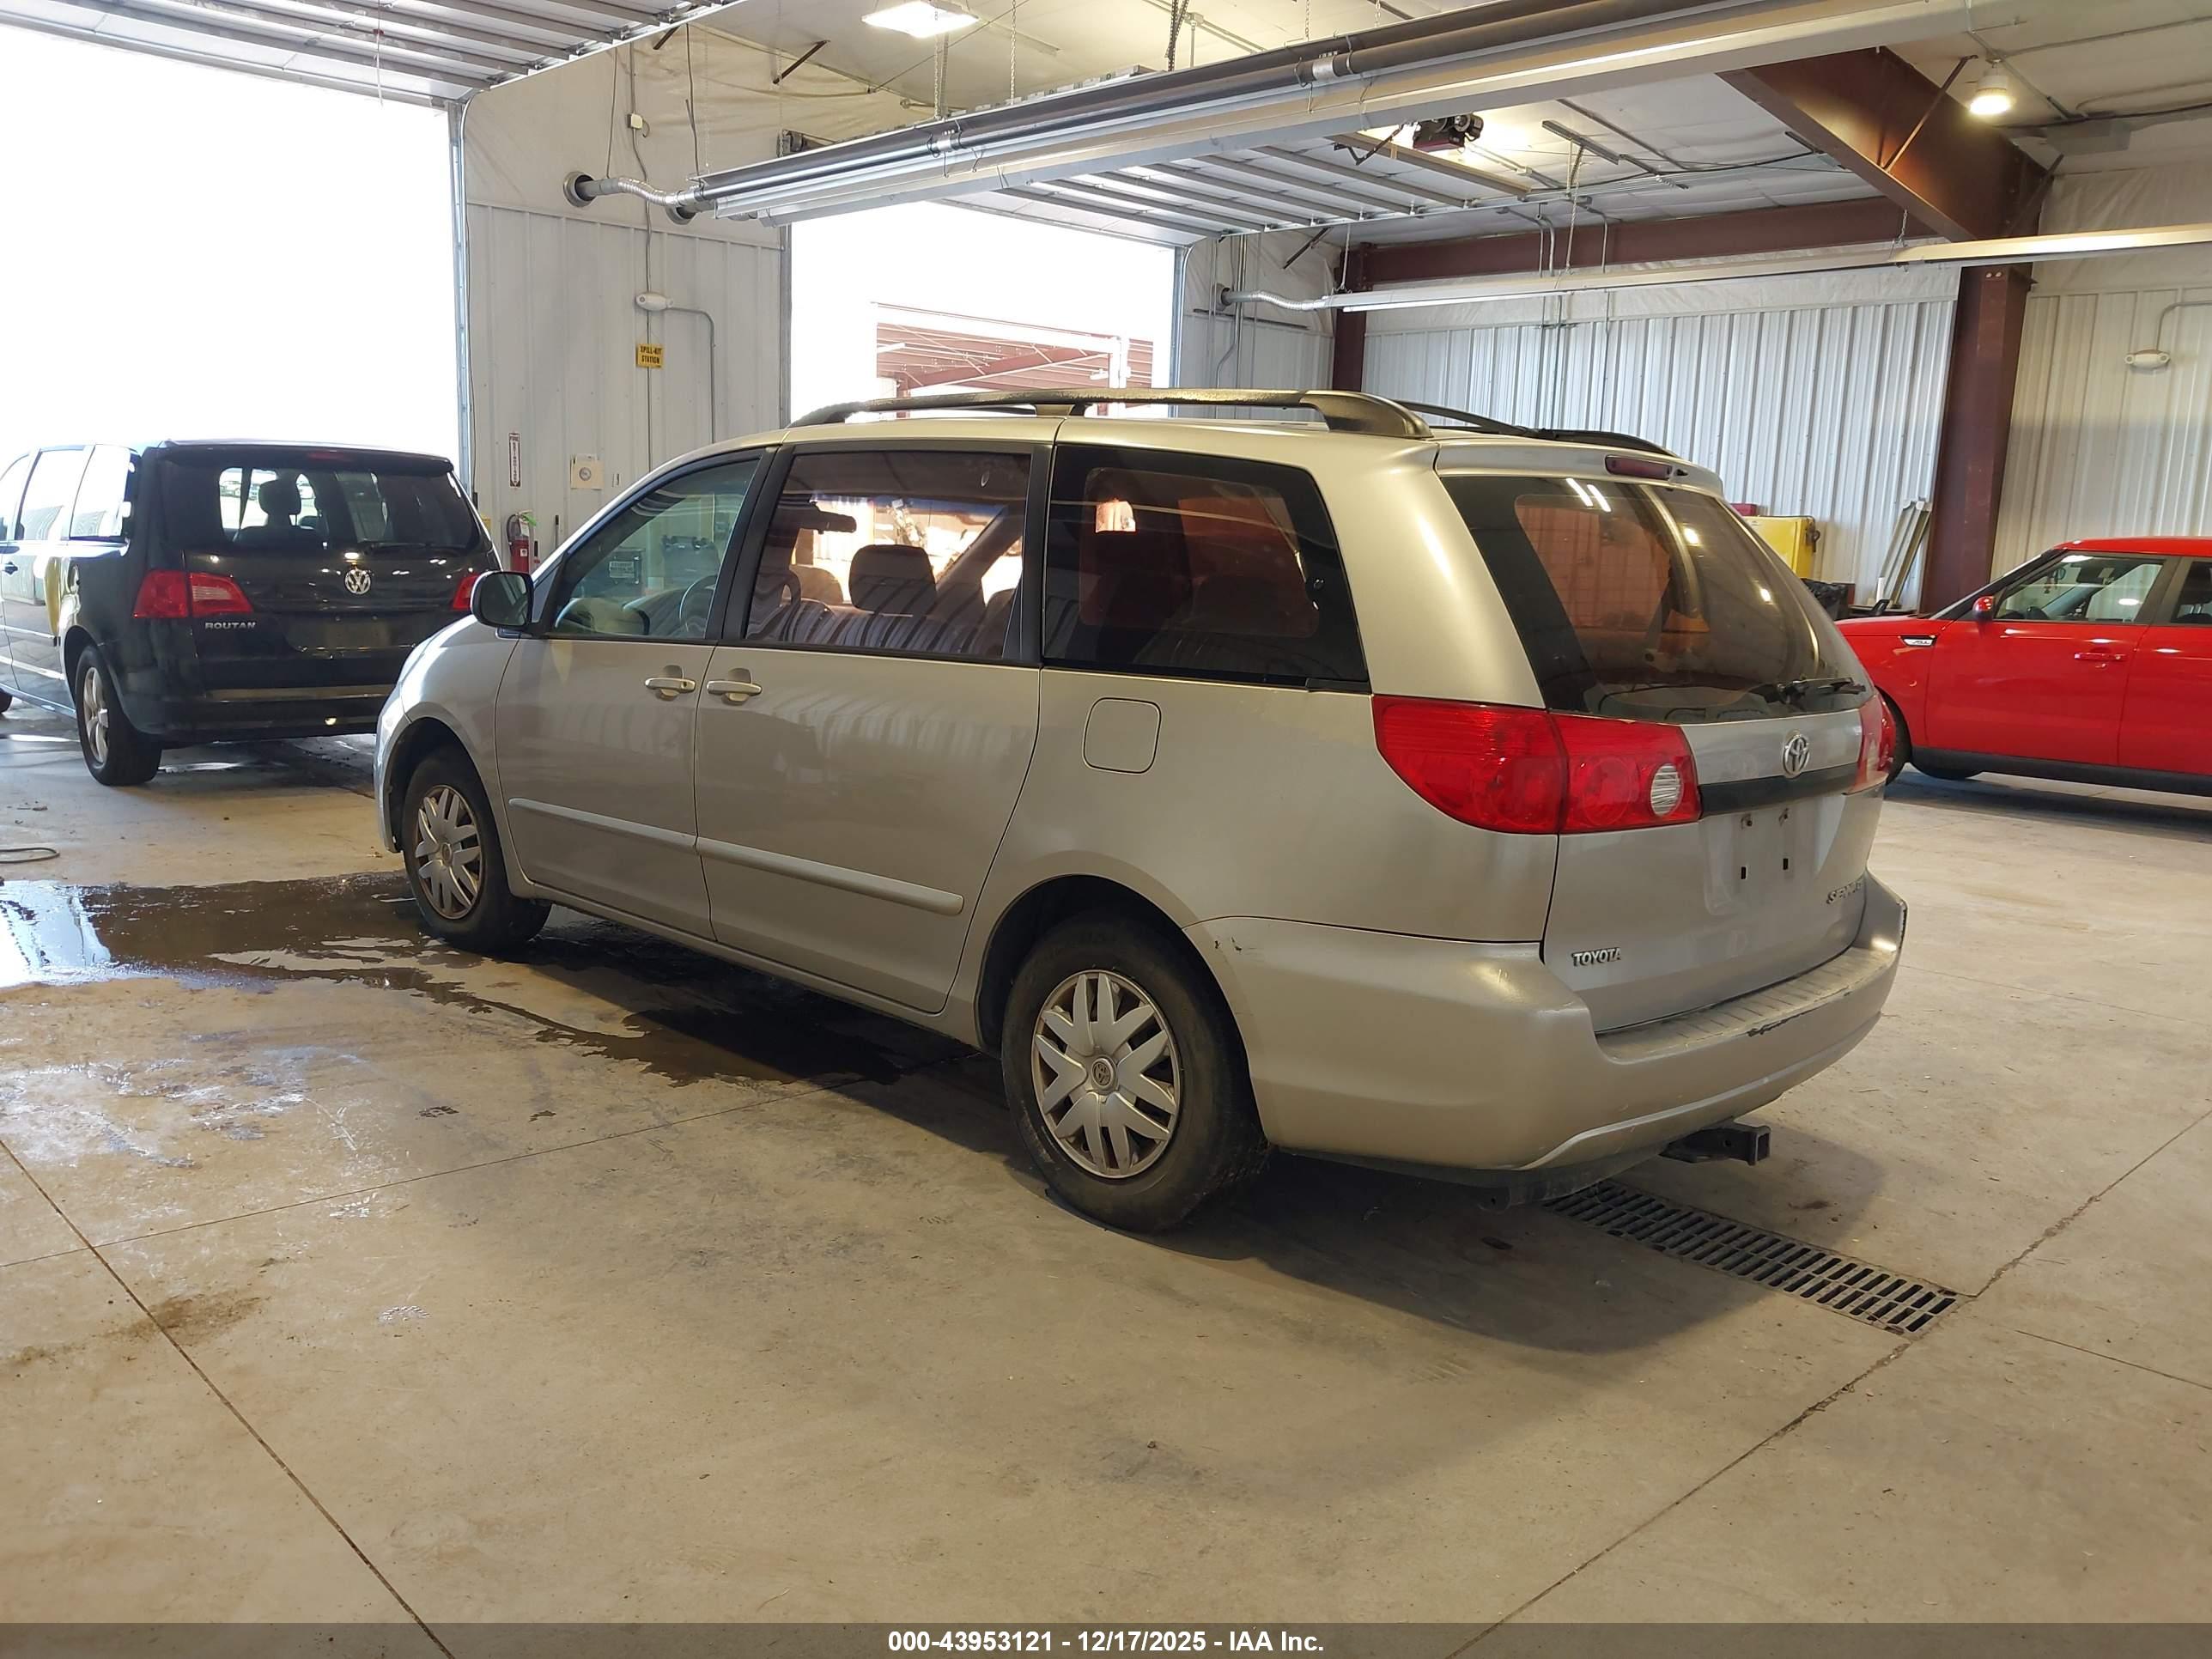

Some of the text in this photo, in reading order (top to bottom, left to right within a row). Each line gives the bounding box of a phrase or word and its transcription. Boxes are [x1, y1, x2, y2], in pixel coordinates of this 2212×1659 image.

[641, 345, 662, 355] SPILL-KIT
[641, 355, 659, 364] STATION
[1571, 947, 1621, 966] TOYOTA
